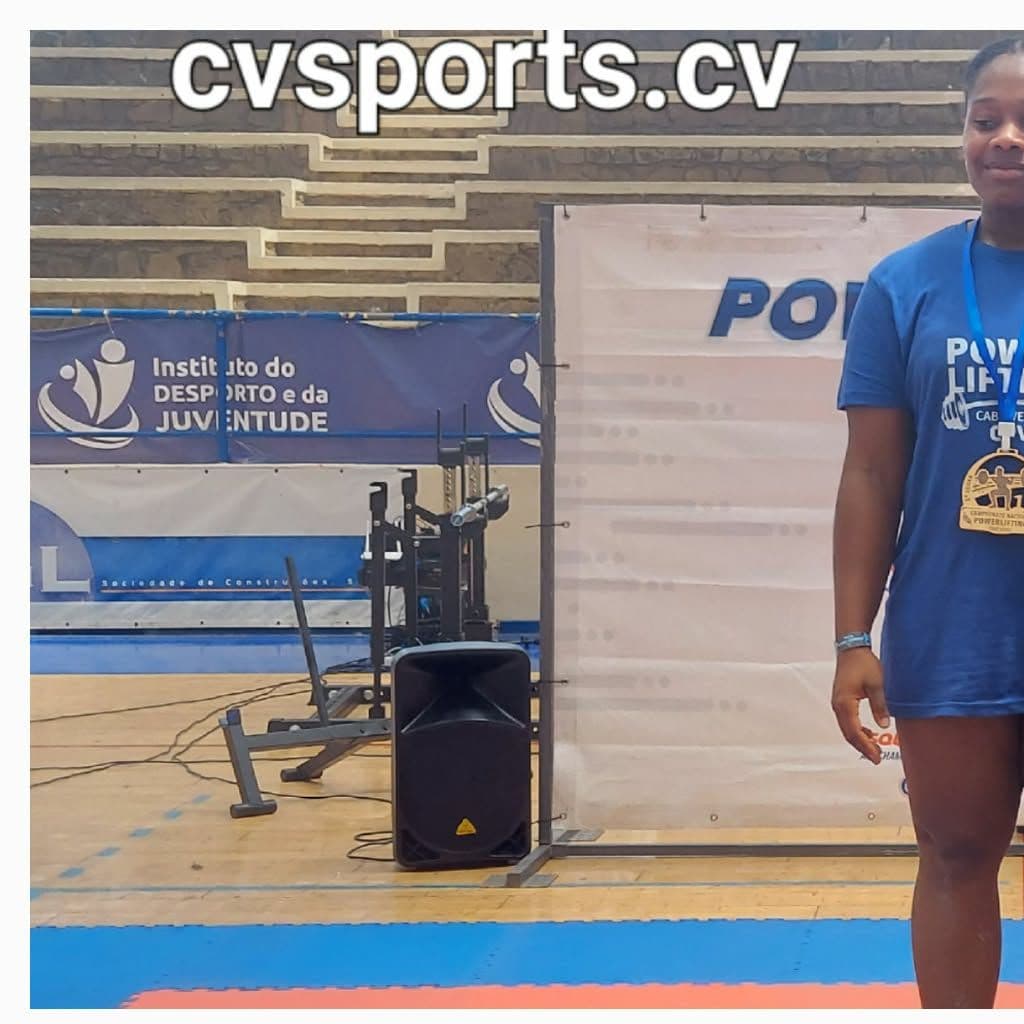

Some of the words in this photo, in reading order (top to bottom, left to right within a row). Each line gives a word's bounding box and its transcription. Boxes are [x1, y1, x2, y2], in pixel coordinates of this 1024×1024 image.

[708, 277, 866, 341] PO
[152, 356, 258, 377] Instituto
[265, 356, 295, 377] do
[154, 384, 276, 403] DESPORTO
[283, 387, 296, 403] e
[302, 384, 329, 403] da
[155, 410, 329, 433] JUVENTUDE
[976, 410, 999, 422] CAB
[198, 578, 214, 587] de
[225, 577, 328, 587] Construões
